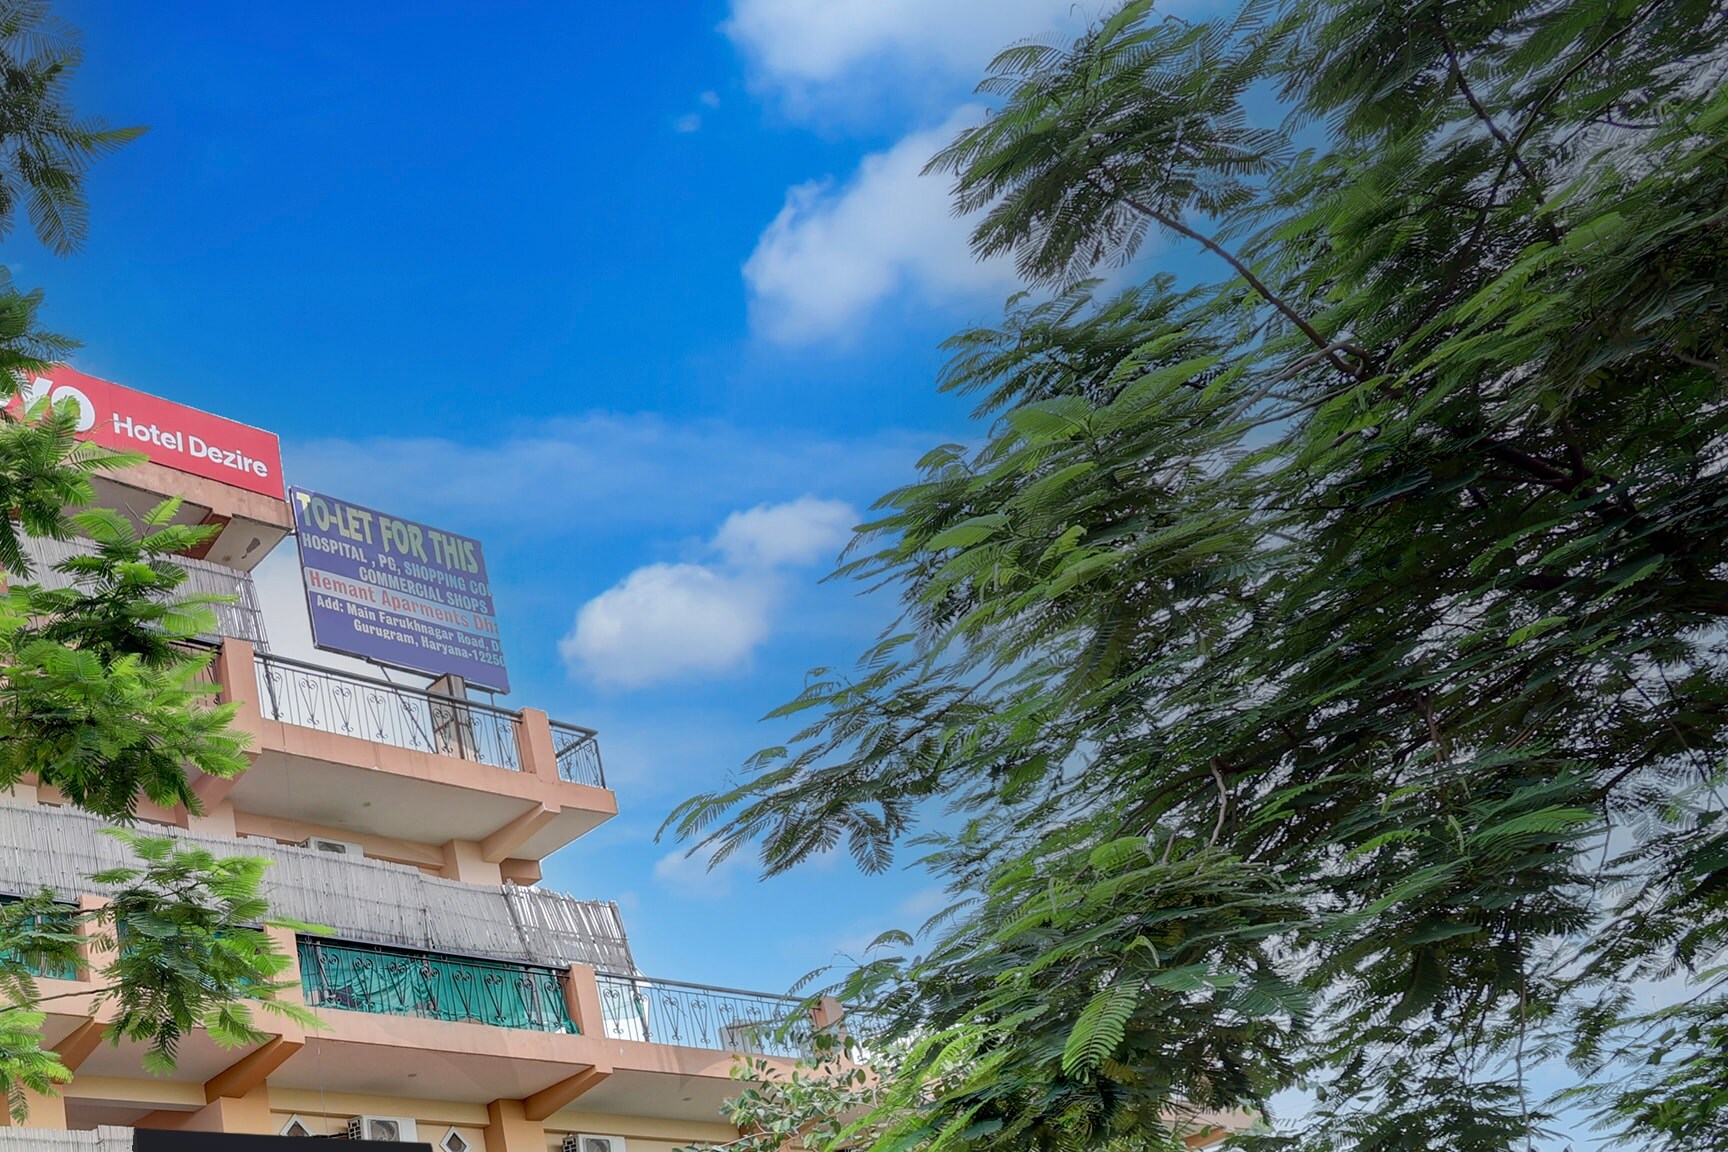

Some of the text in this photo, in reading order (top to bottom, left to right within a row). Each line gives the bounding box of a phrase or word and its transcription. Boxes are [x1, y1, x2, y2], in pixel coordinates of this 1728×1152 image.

[113, 412, 268, 478] Hotel Dezire
[296, 491, 479, 574] TO-LET FOR THIS
[302, 532, 368, 563] HOSPITAL
[378, 553, 401, 575] PG,
[403, 561, 466, 592] SHOPPING
[359, 566, 489, 614] COMMERCIAL SHOPS
[309, 570, 376, 603] Hemant
[381, 589, 470, 628] Aparments
[317, 594, 344, 612] Add:
[346, 602, 376, 621] Main
[379, 611, 454, 641] Farukhnagar
[457, 631, 489, 652] Road,
[353, 618, 419, 647] Gurugram,
